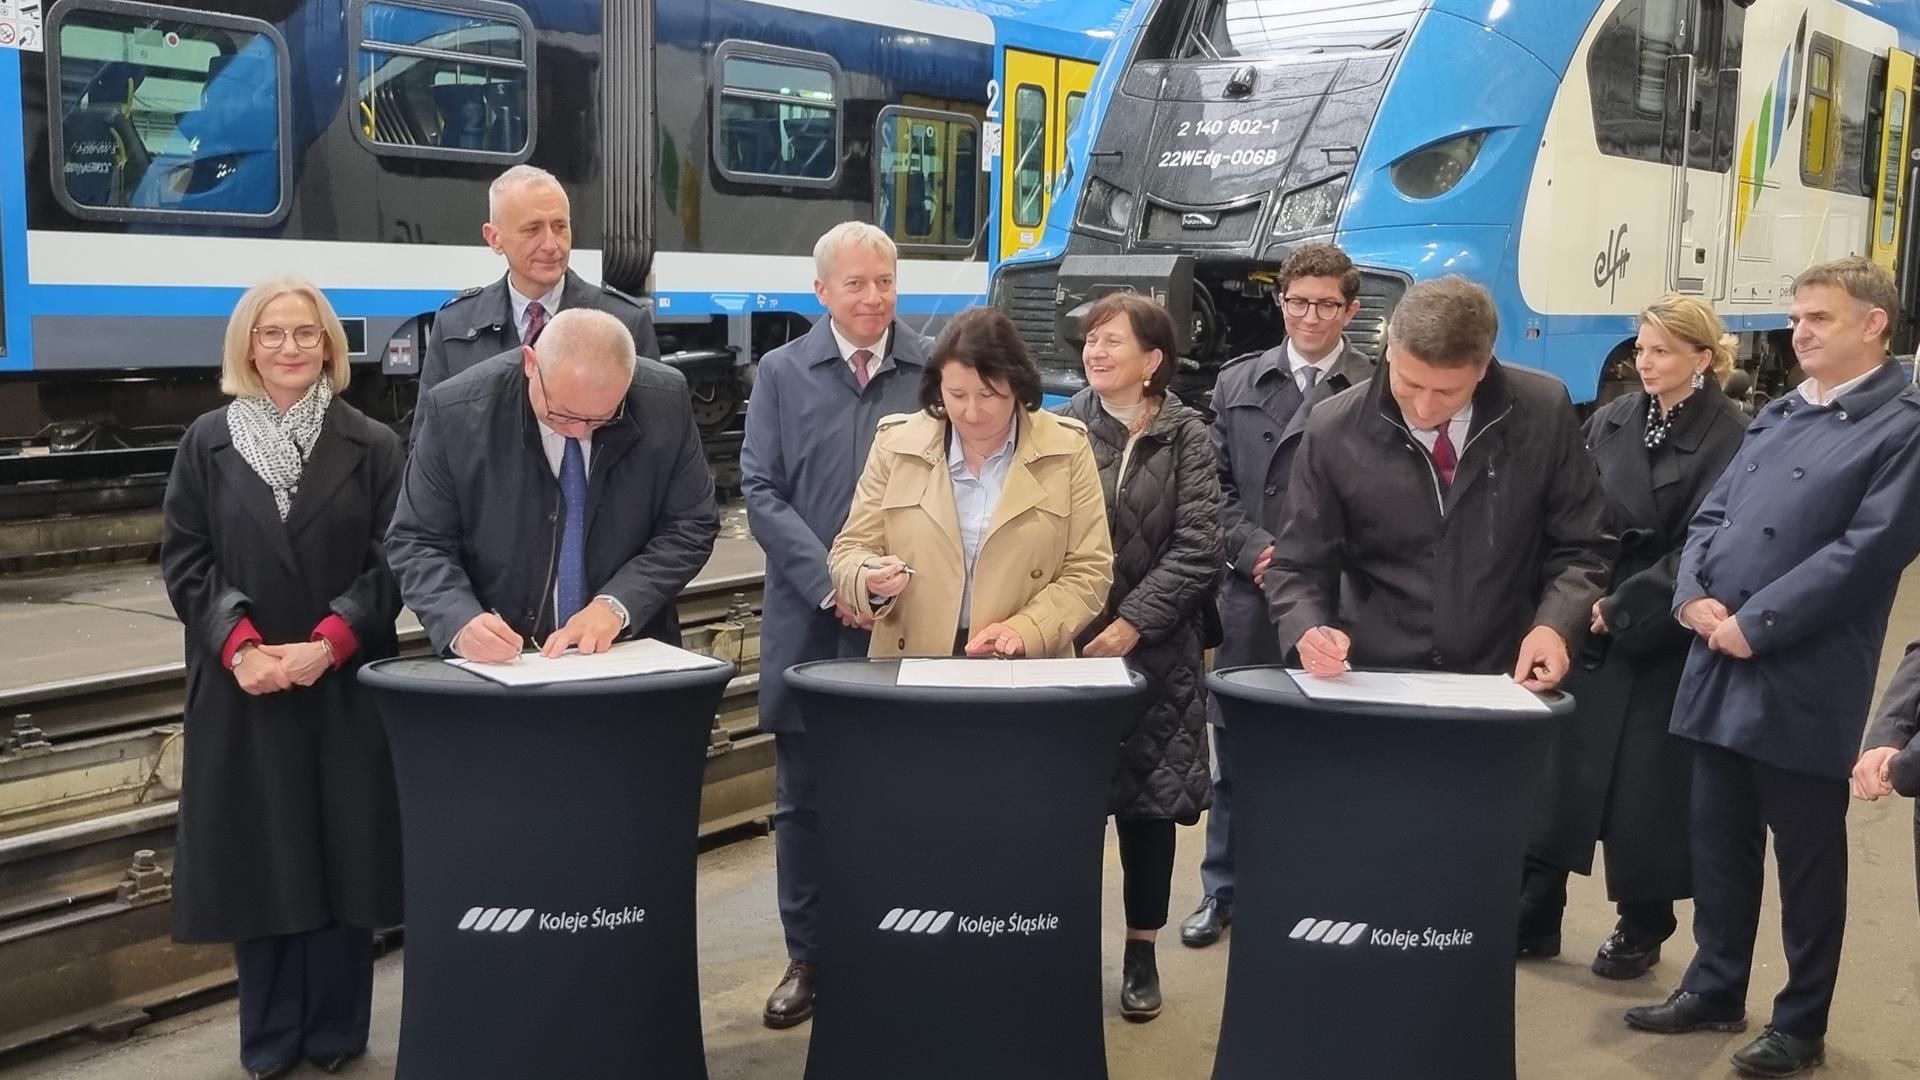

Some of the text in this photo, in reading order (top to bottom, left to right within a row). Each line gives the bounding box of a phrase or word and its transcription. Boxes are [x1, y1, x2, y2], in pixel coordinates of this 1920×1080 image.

[1679, 19, 1685, 36] 2
[986, 79, 1000, 118] 2
[1177, 119, 1280, 137] 2 140 802-1
[1158, 149, 1278, 169] 22WEdg-006B
[539, 906, 645, 933] Koleje Śląskie
[957, 912, 1058, 937] Koleje Śląskie
[1370, 926, 1473, 950] Koleje Śląskie
